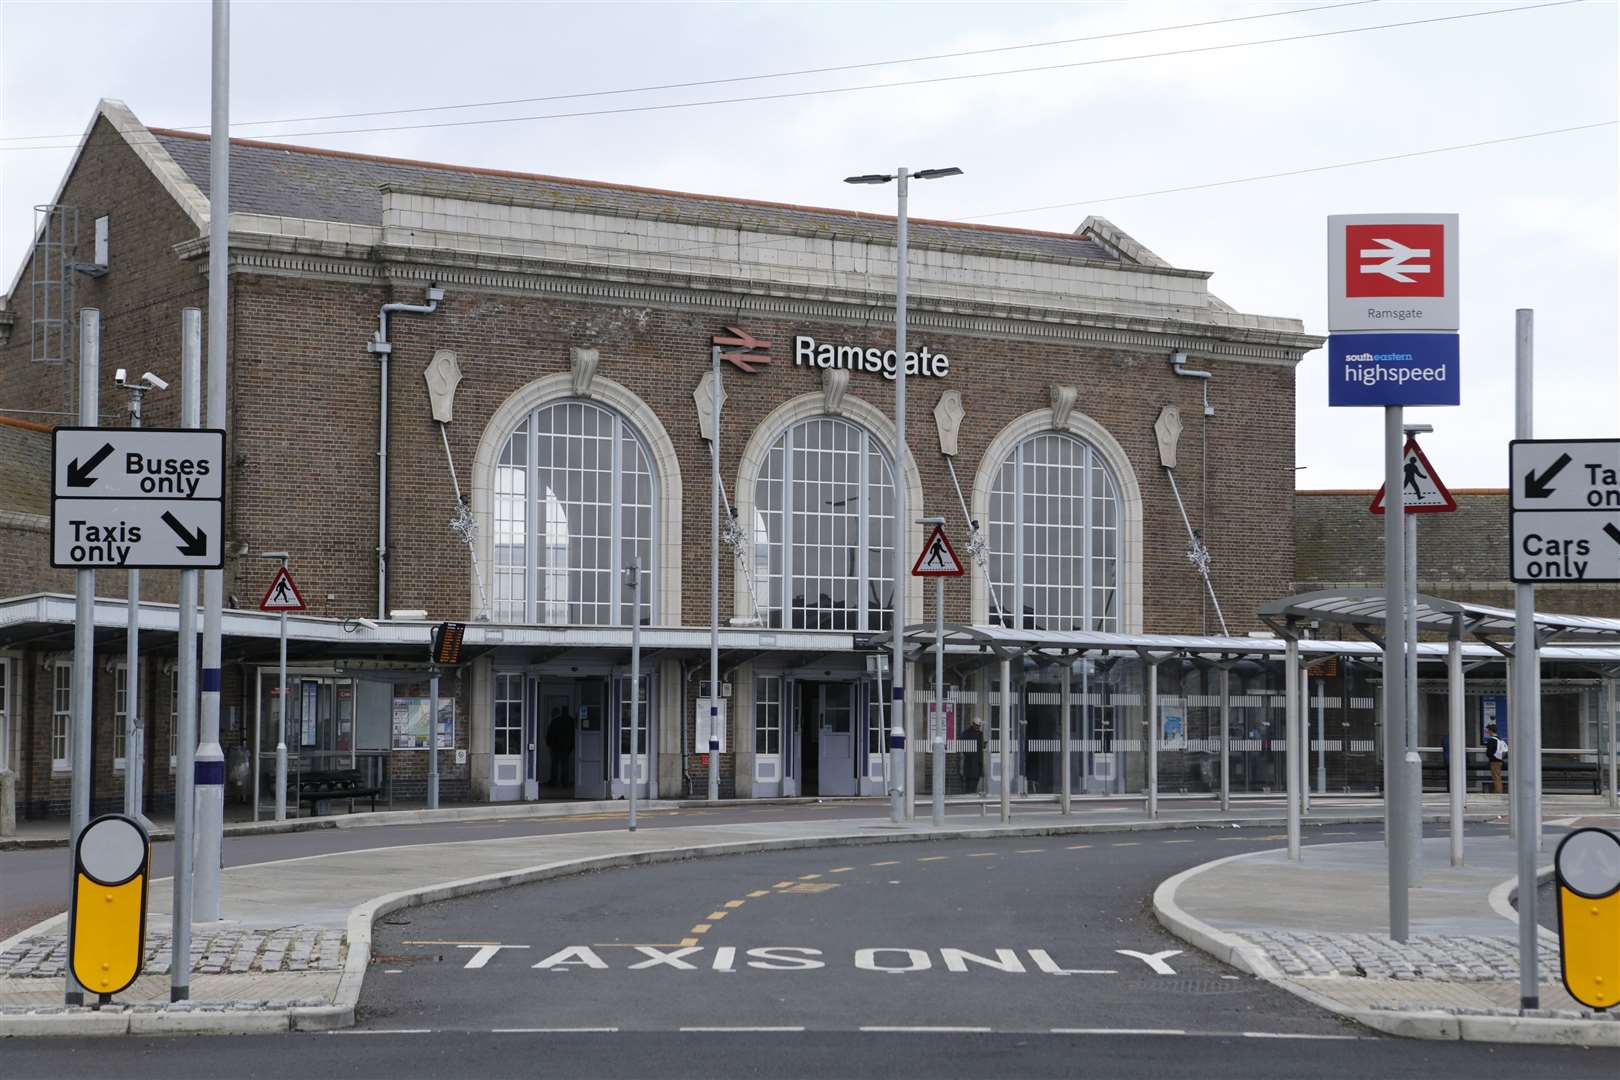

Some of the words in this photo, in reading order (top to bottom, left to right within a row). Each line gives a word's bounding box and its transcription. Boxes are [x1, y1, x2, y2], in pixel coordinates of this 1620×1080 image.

[1368, 308, 1423, 320] Ramsgate
[794, 335, 949, 380] Ramsgate
[1345, 364, 1446, 386] highspeed
[126, 452, 210, 476] Buses
[1584, 463, 1620, 486] Ta
[140, 471, 200, 498] only
[69, 520, 142, 543] Taxis
[70, 540, 131, 566] only
[1523, 533, 1590, 556] Cars
[1527, 555, 1588, 579] only
[456, 944, 826, 971] TAXIS
[854, 947, 1183, 975] ONLY
